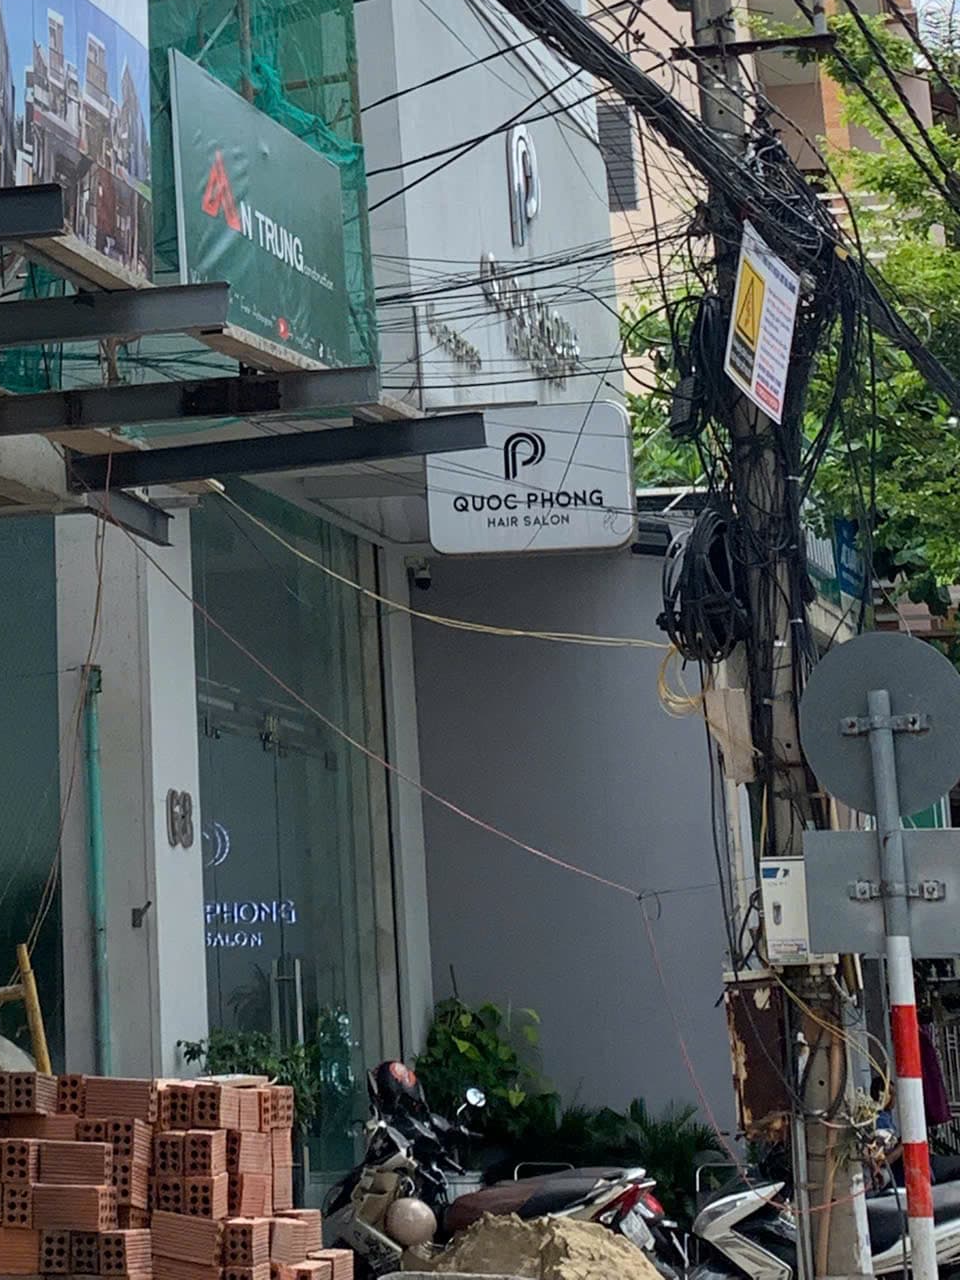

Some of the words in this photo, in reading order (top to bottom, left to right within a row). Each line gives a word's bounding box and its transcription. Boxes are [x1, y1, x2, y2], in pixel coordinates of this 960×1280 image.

[255, 210, 304, 272] TRUNG
[452, 494, 518, 513] QUOC
[527, 489, 604, 509] PHONG
[487, 516, 519, 528] HAIR
[523, 514, 570, 527] SALON
[205, 900, 297, 925] PHONG
